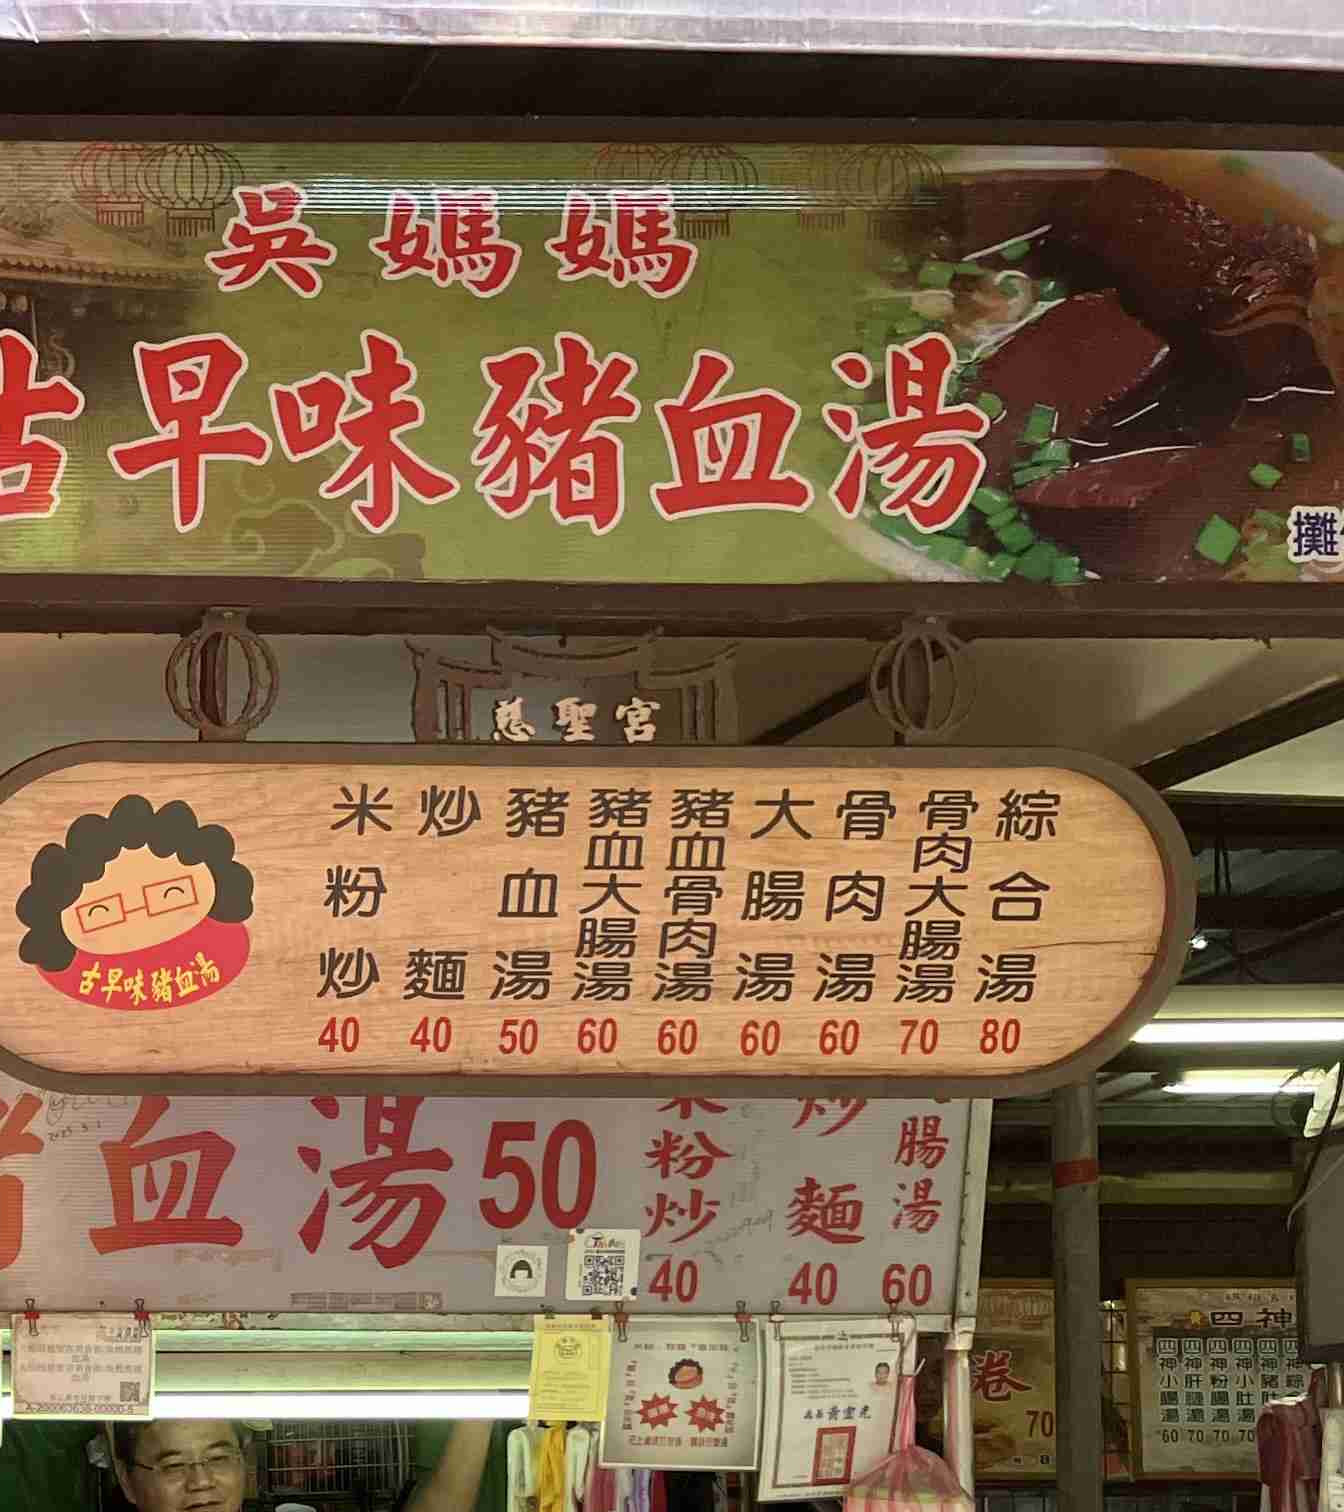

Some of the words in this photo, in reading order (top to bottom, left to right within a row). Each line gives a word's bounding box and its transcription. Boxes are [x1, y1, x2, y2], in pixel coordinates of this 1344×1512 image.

[212, 186, 692, 294] 吳媽媽
[1293, 511, 1339, 557] 攤
[492, 696, 661, 743] 慈聖宮
[317, 783, 393, 999] 米粉炒
[403, 785, 481, 1001] 炒麵
[489, 787, 570, 1002] 豬血湯
[570, 787, 652, 1002] 豬血大腸湯
[651, 787, 735, 1002] 豬血骨肉湯
[732, 788, 815, 1003] 大腸湯
[812, 789, 897, 1003] 骨肉湯
[892, 789, 979, 1004] 骨肉大腸湯
[973, 789, 1061, 1003] 綜合湯
[79, 951, 220, 1006] 古早味豬血湯
[318, 1017, 359, 1053] 40
[410, 1017, 452, 1053] 40
[499, 1018, 538, 1055] 50
[577, 1017, 617, 1054] 60
[657, 1019, 699, 1055] 60
[740, 1020, 780, 1056] 60
[819, 1019, 860, 1055] 60
[899, 1019, 939, 1055] 70
[980, 1019, 1021, 1055] 80
[479, 1120, 596, 1229] 50
[648, 1257, 699, 1303] 40
[788, 1262, 838, 1306] 40
[882, 1263, 933, 1307] 60
[1025, 1410, 1053, 1438] 70
